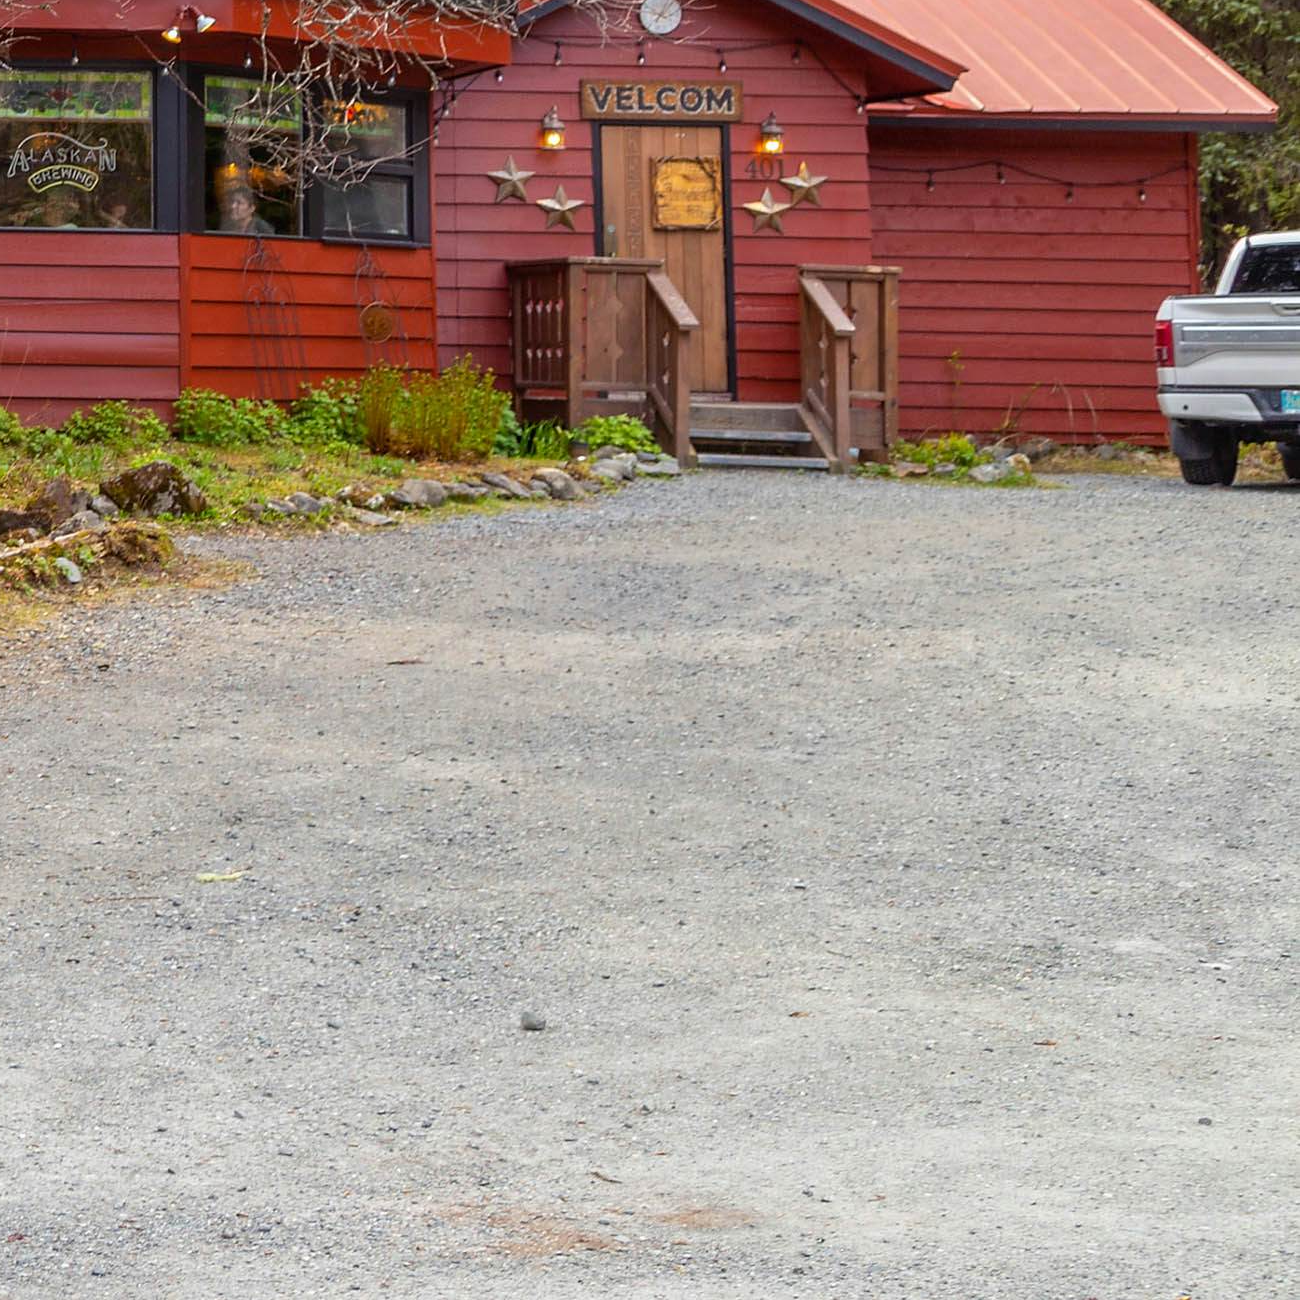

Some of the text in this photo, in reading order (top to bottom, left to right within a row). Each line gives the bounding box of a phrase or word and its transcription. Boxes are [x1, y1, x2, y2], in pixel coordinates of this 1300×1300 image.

[588, 85, 735, 114] VELCOM
[7, 132, 117, 178] ALASKAN
[32, 167, 95, 187] BREWING
[744, 157, 784, 179] 401
